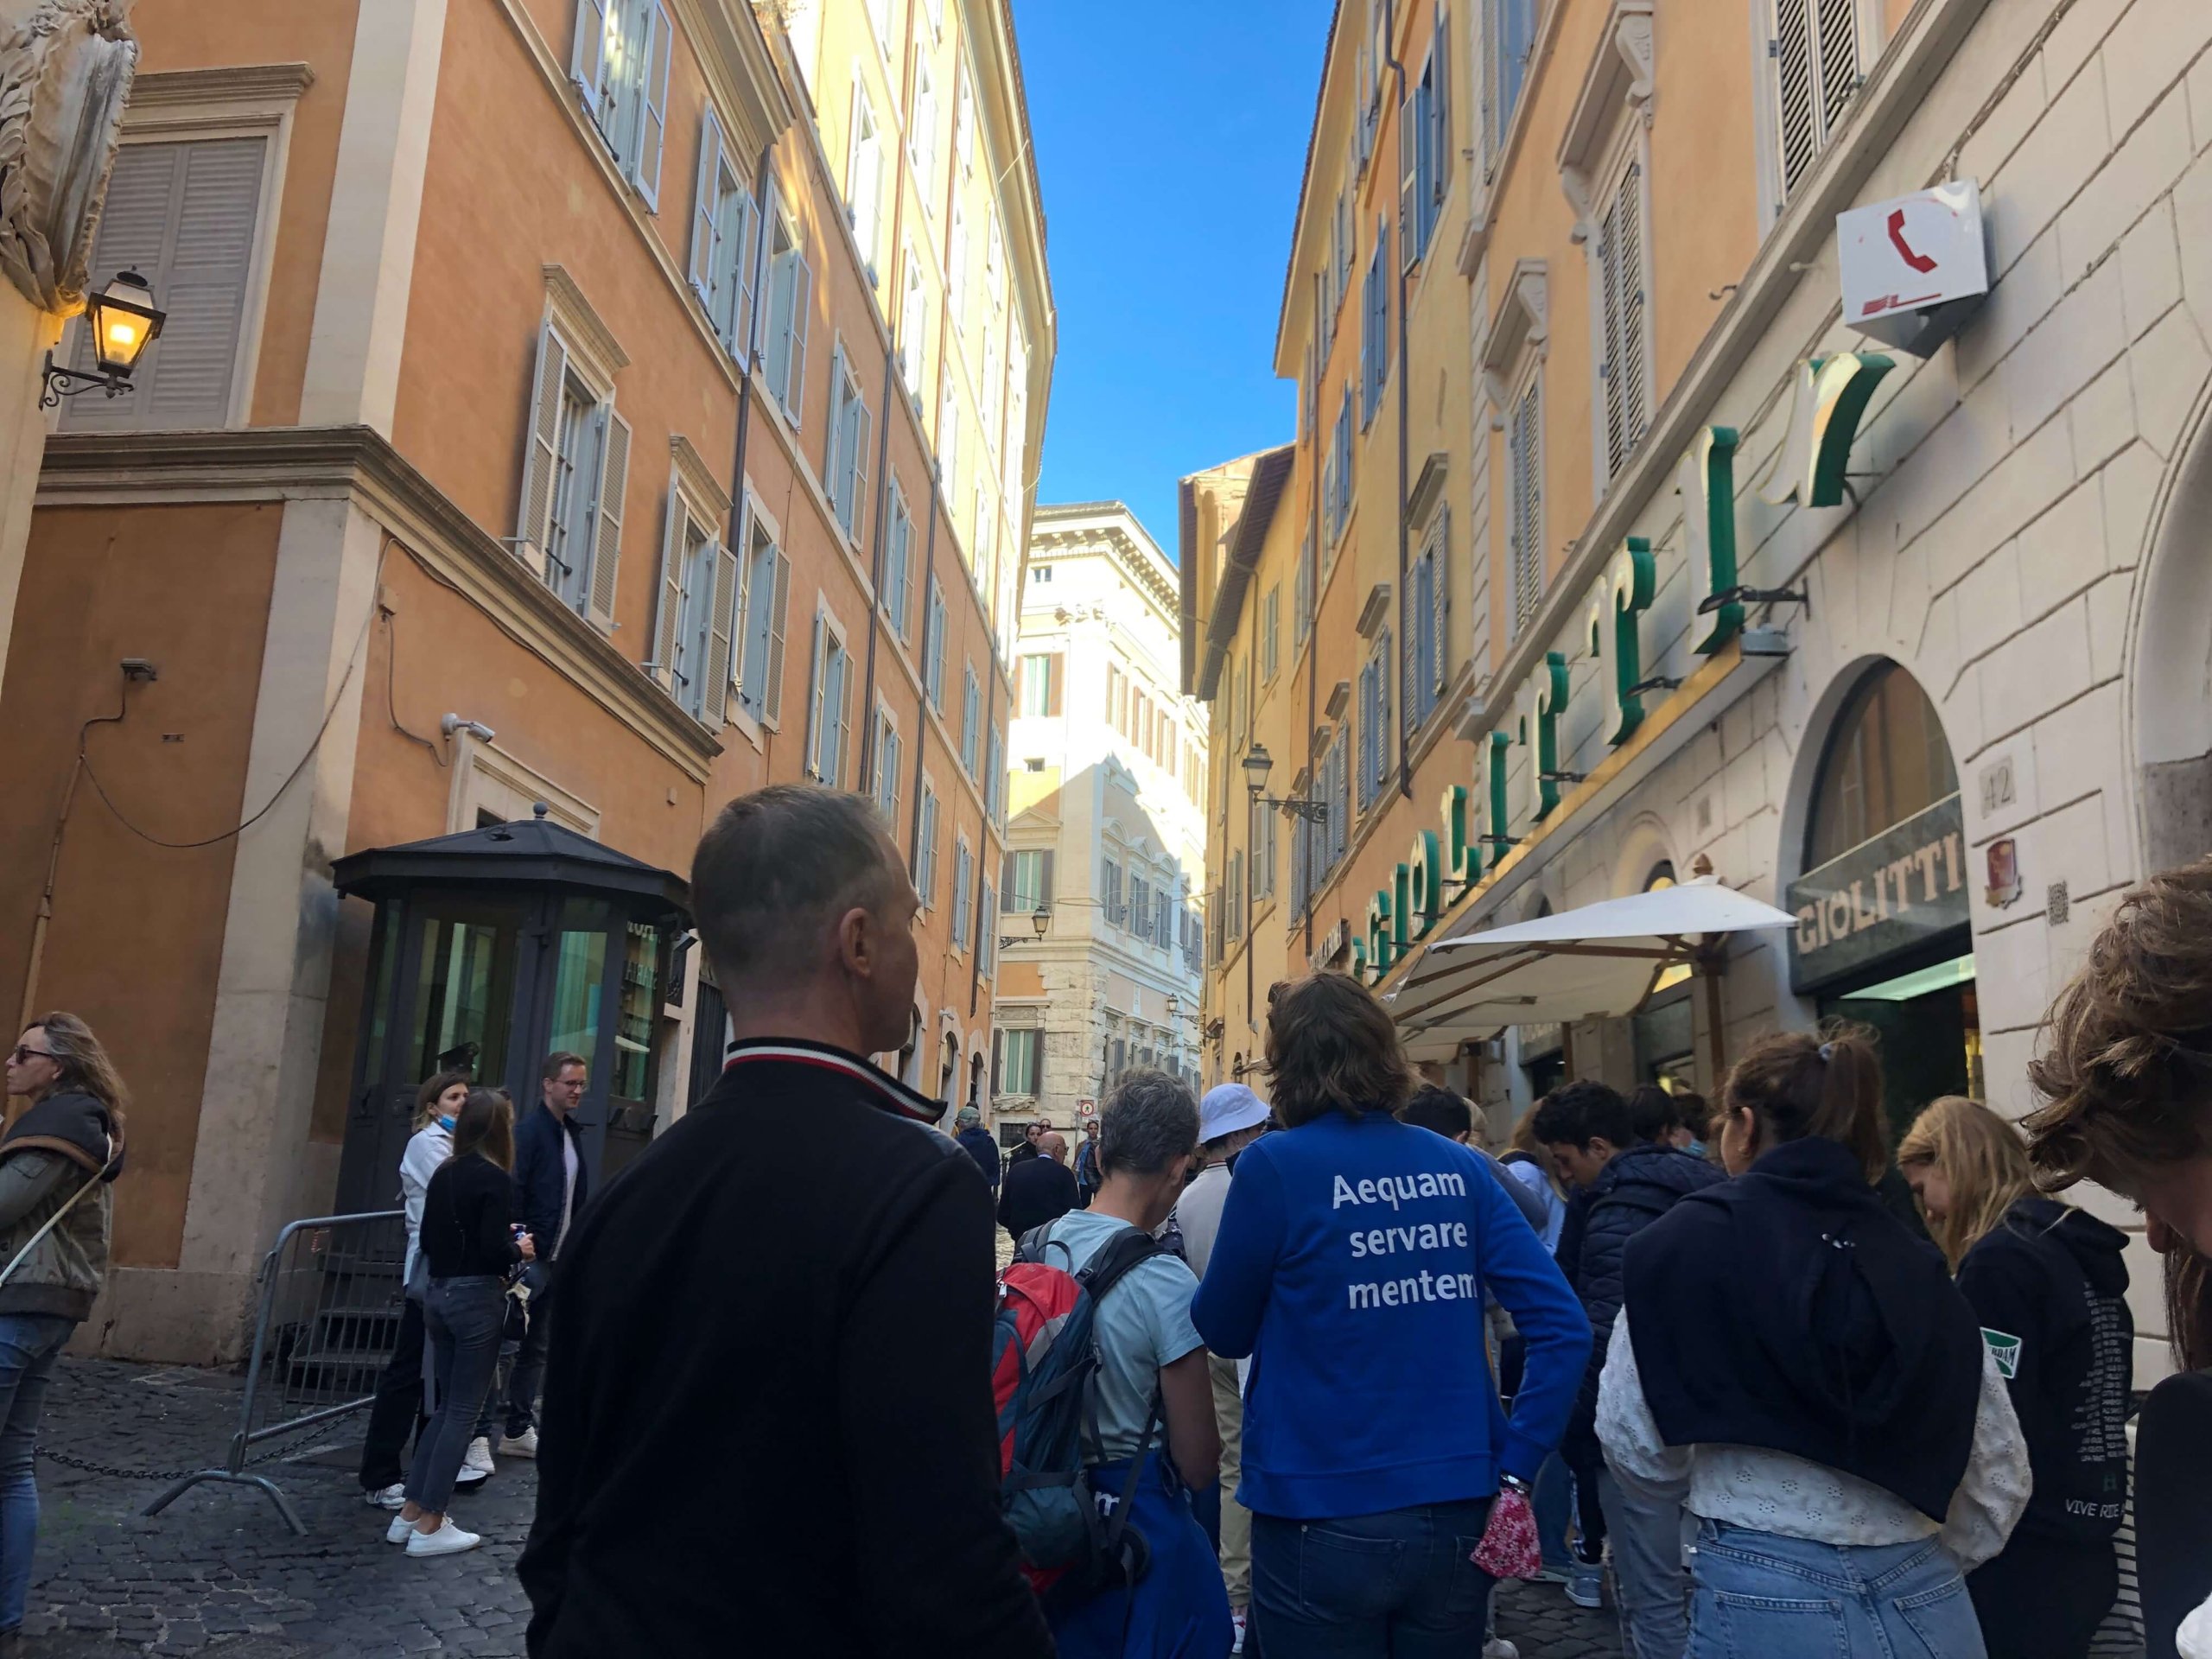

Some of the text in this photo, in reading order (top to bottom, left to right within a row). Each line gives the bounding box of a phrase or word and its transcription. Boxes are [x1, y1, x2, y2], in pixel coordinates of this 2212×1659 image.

[1366, 425, 1745, 987] GIOLITTI
[1984, 766, 2012, 810] 42
[1796, 830, 1963, 955] GIOLITTI
[1332, 1173, 1466, 1211] Aequam
[1349, 1222, 1468, 1258] servare
[1348, 1269, 1478, 1310] mentem
[1988, 1345, 2018, 1367] RDAM
[2065, 1498, 2099, 1517] VIVE
